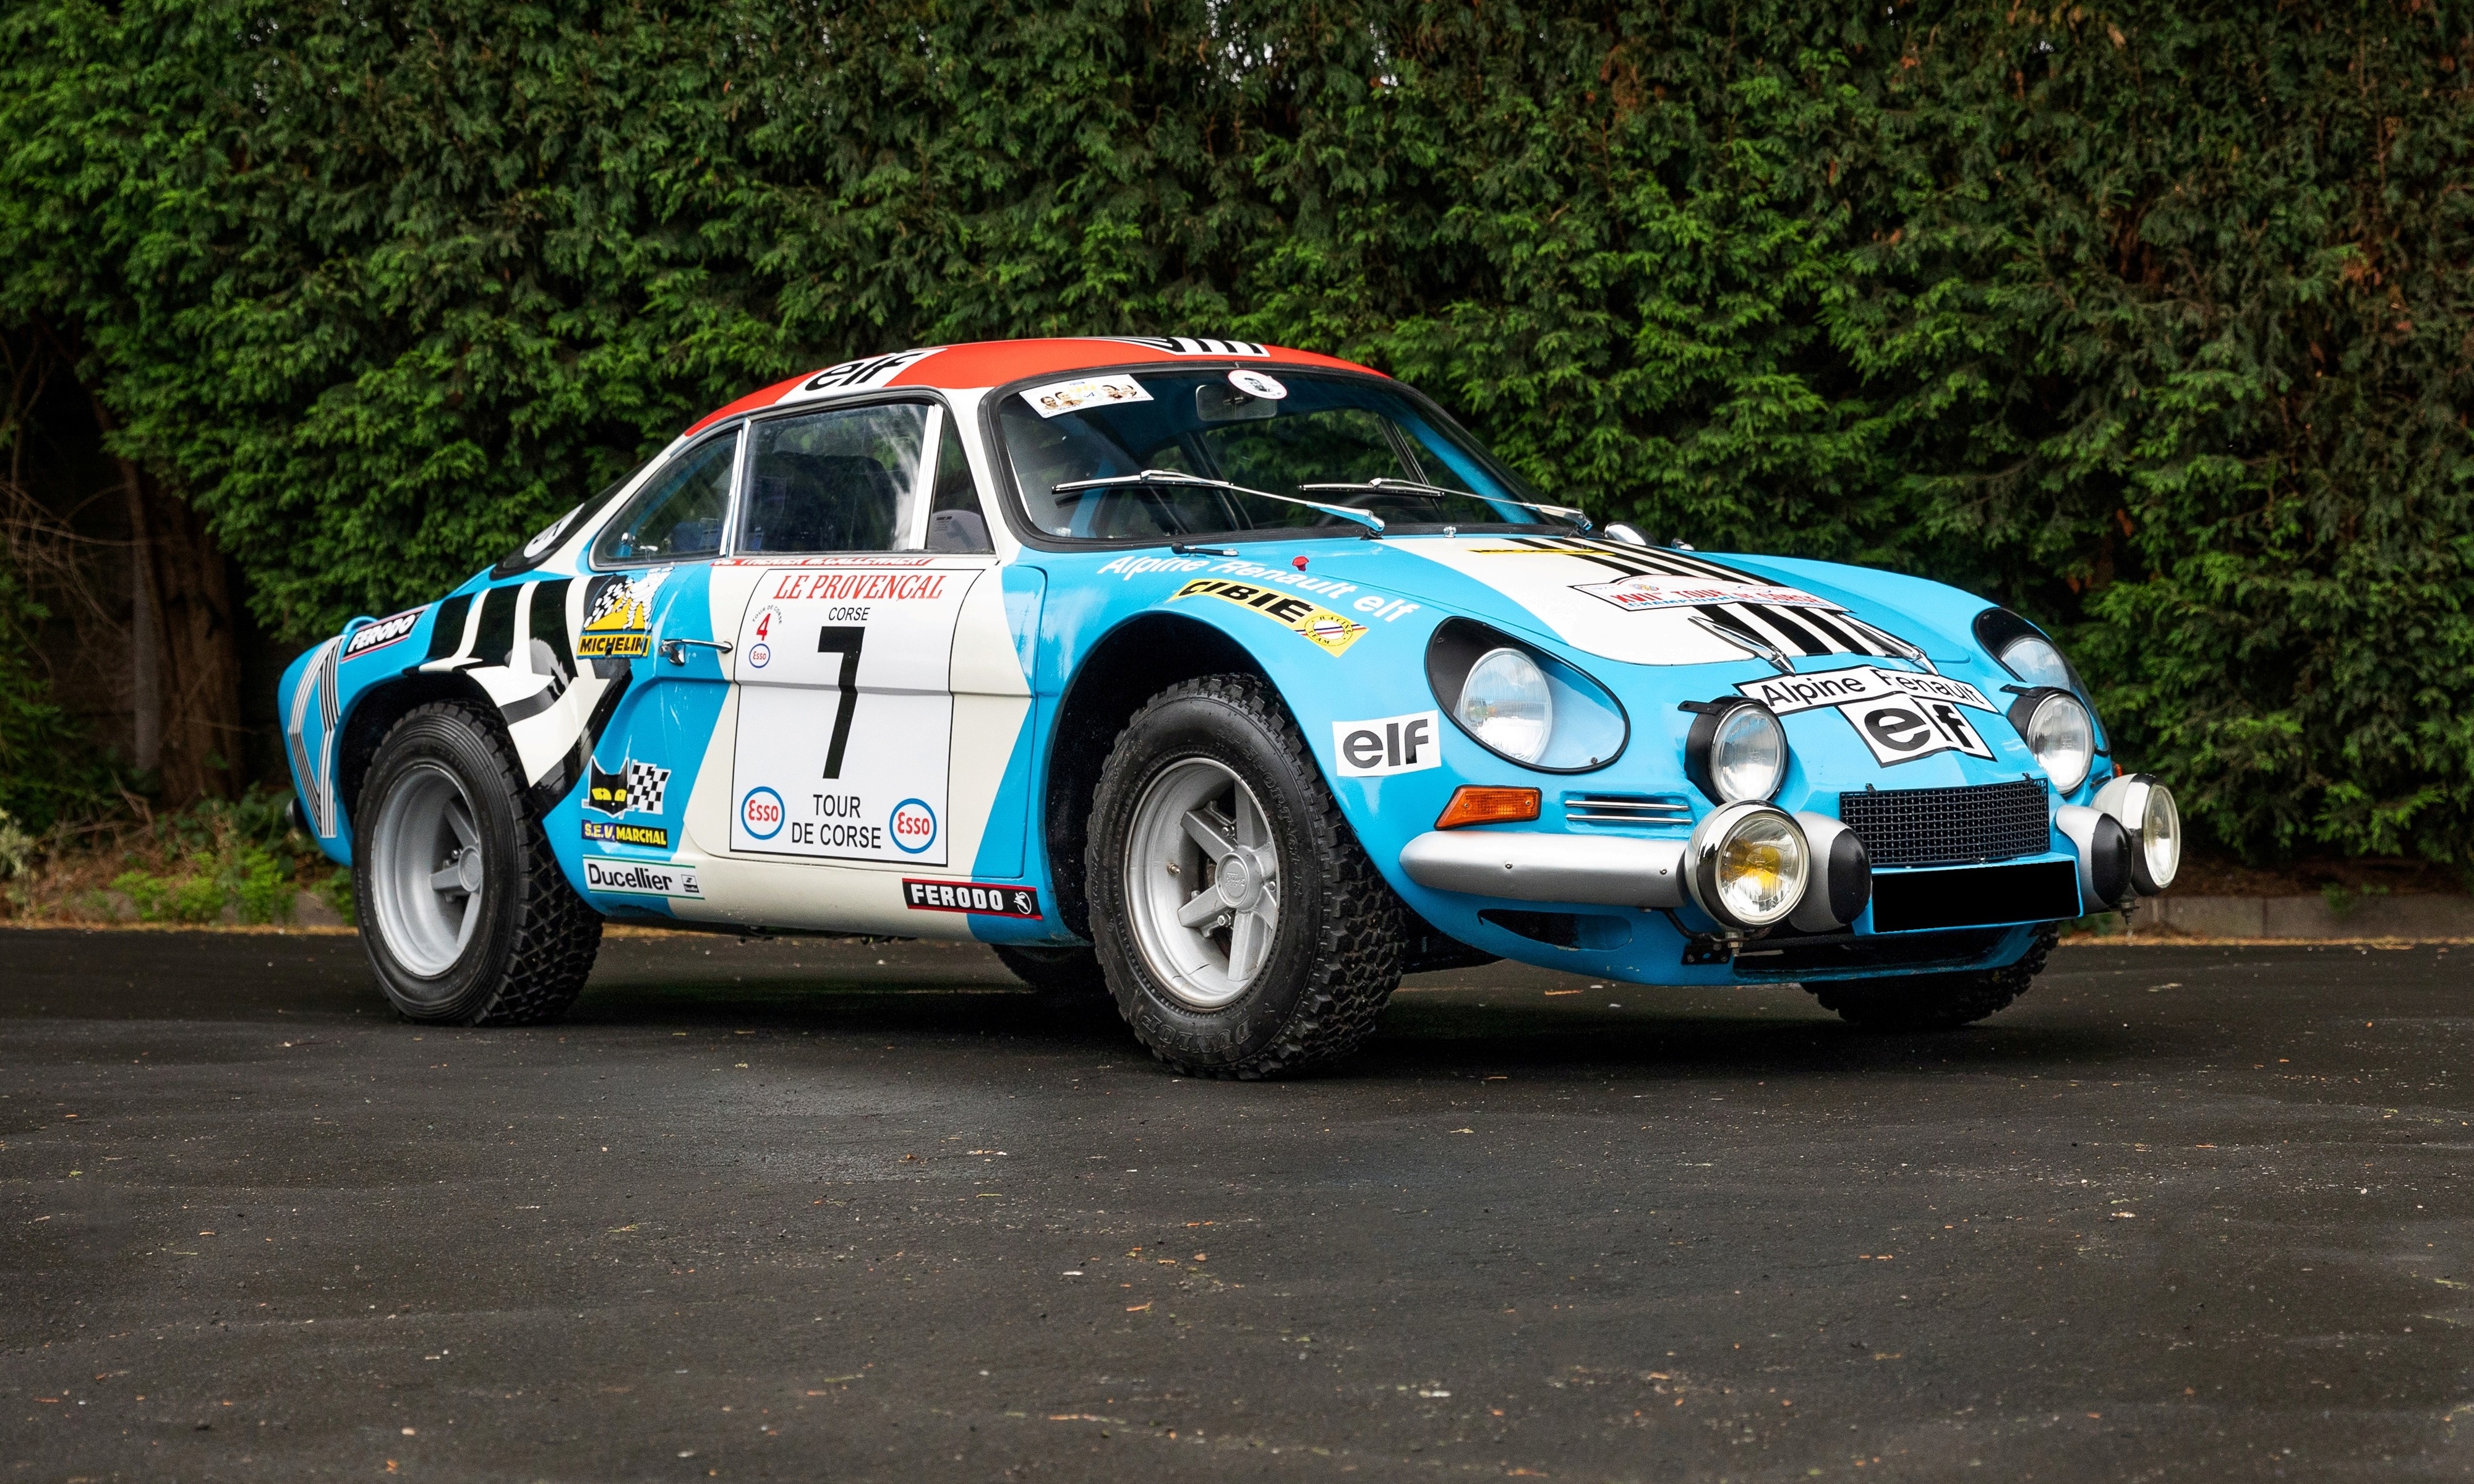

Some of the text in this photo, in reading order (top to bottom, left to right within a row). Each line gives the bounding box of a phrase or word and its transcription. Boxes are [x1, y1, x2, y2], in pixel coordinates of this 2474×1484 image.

[805, 352, 927, 391] elf
[773, 574, 946, 602] LE PROVENÇAL
[1097, 555, 1421, 623] Alpine Renault elf
[756, 613, 771, 641] 4
[828, 607, 870, 621] CORSE
[347, 614, 416, 653] FERODO
[580, 637, 649, 654] MICHELIN
[1308, 629, 1330, 644] TEAM
[817, 626, 865, 779] 7
[1761, 678, 1866, 707] Alpine
[1342, 719, 1429, 768] elf
[813, 794, 861, 819] TOUR
[584, 823, 667, 845] S.E.V. MARCHAL
[792, 822, 881, 849] DE CORSE
[588, 863, 673, 891] Ducellier
[910, 884, 1003, 911] FERODO
[1141, 1014, 1253, 1053] DUNLOP
